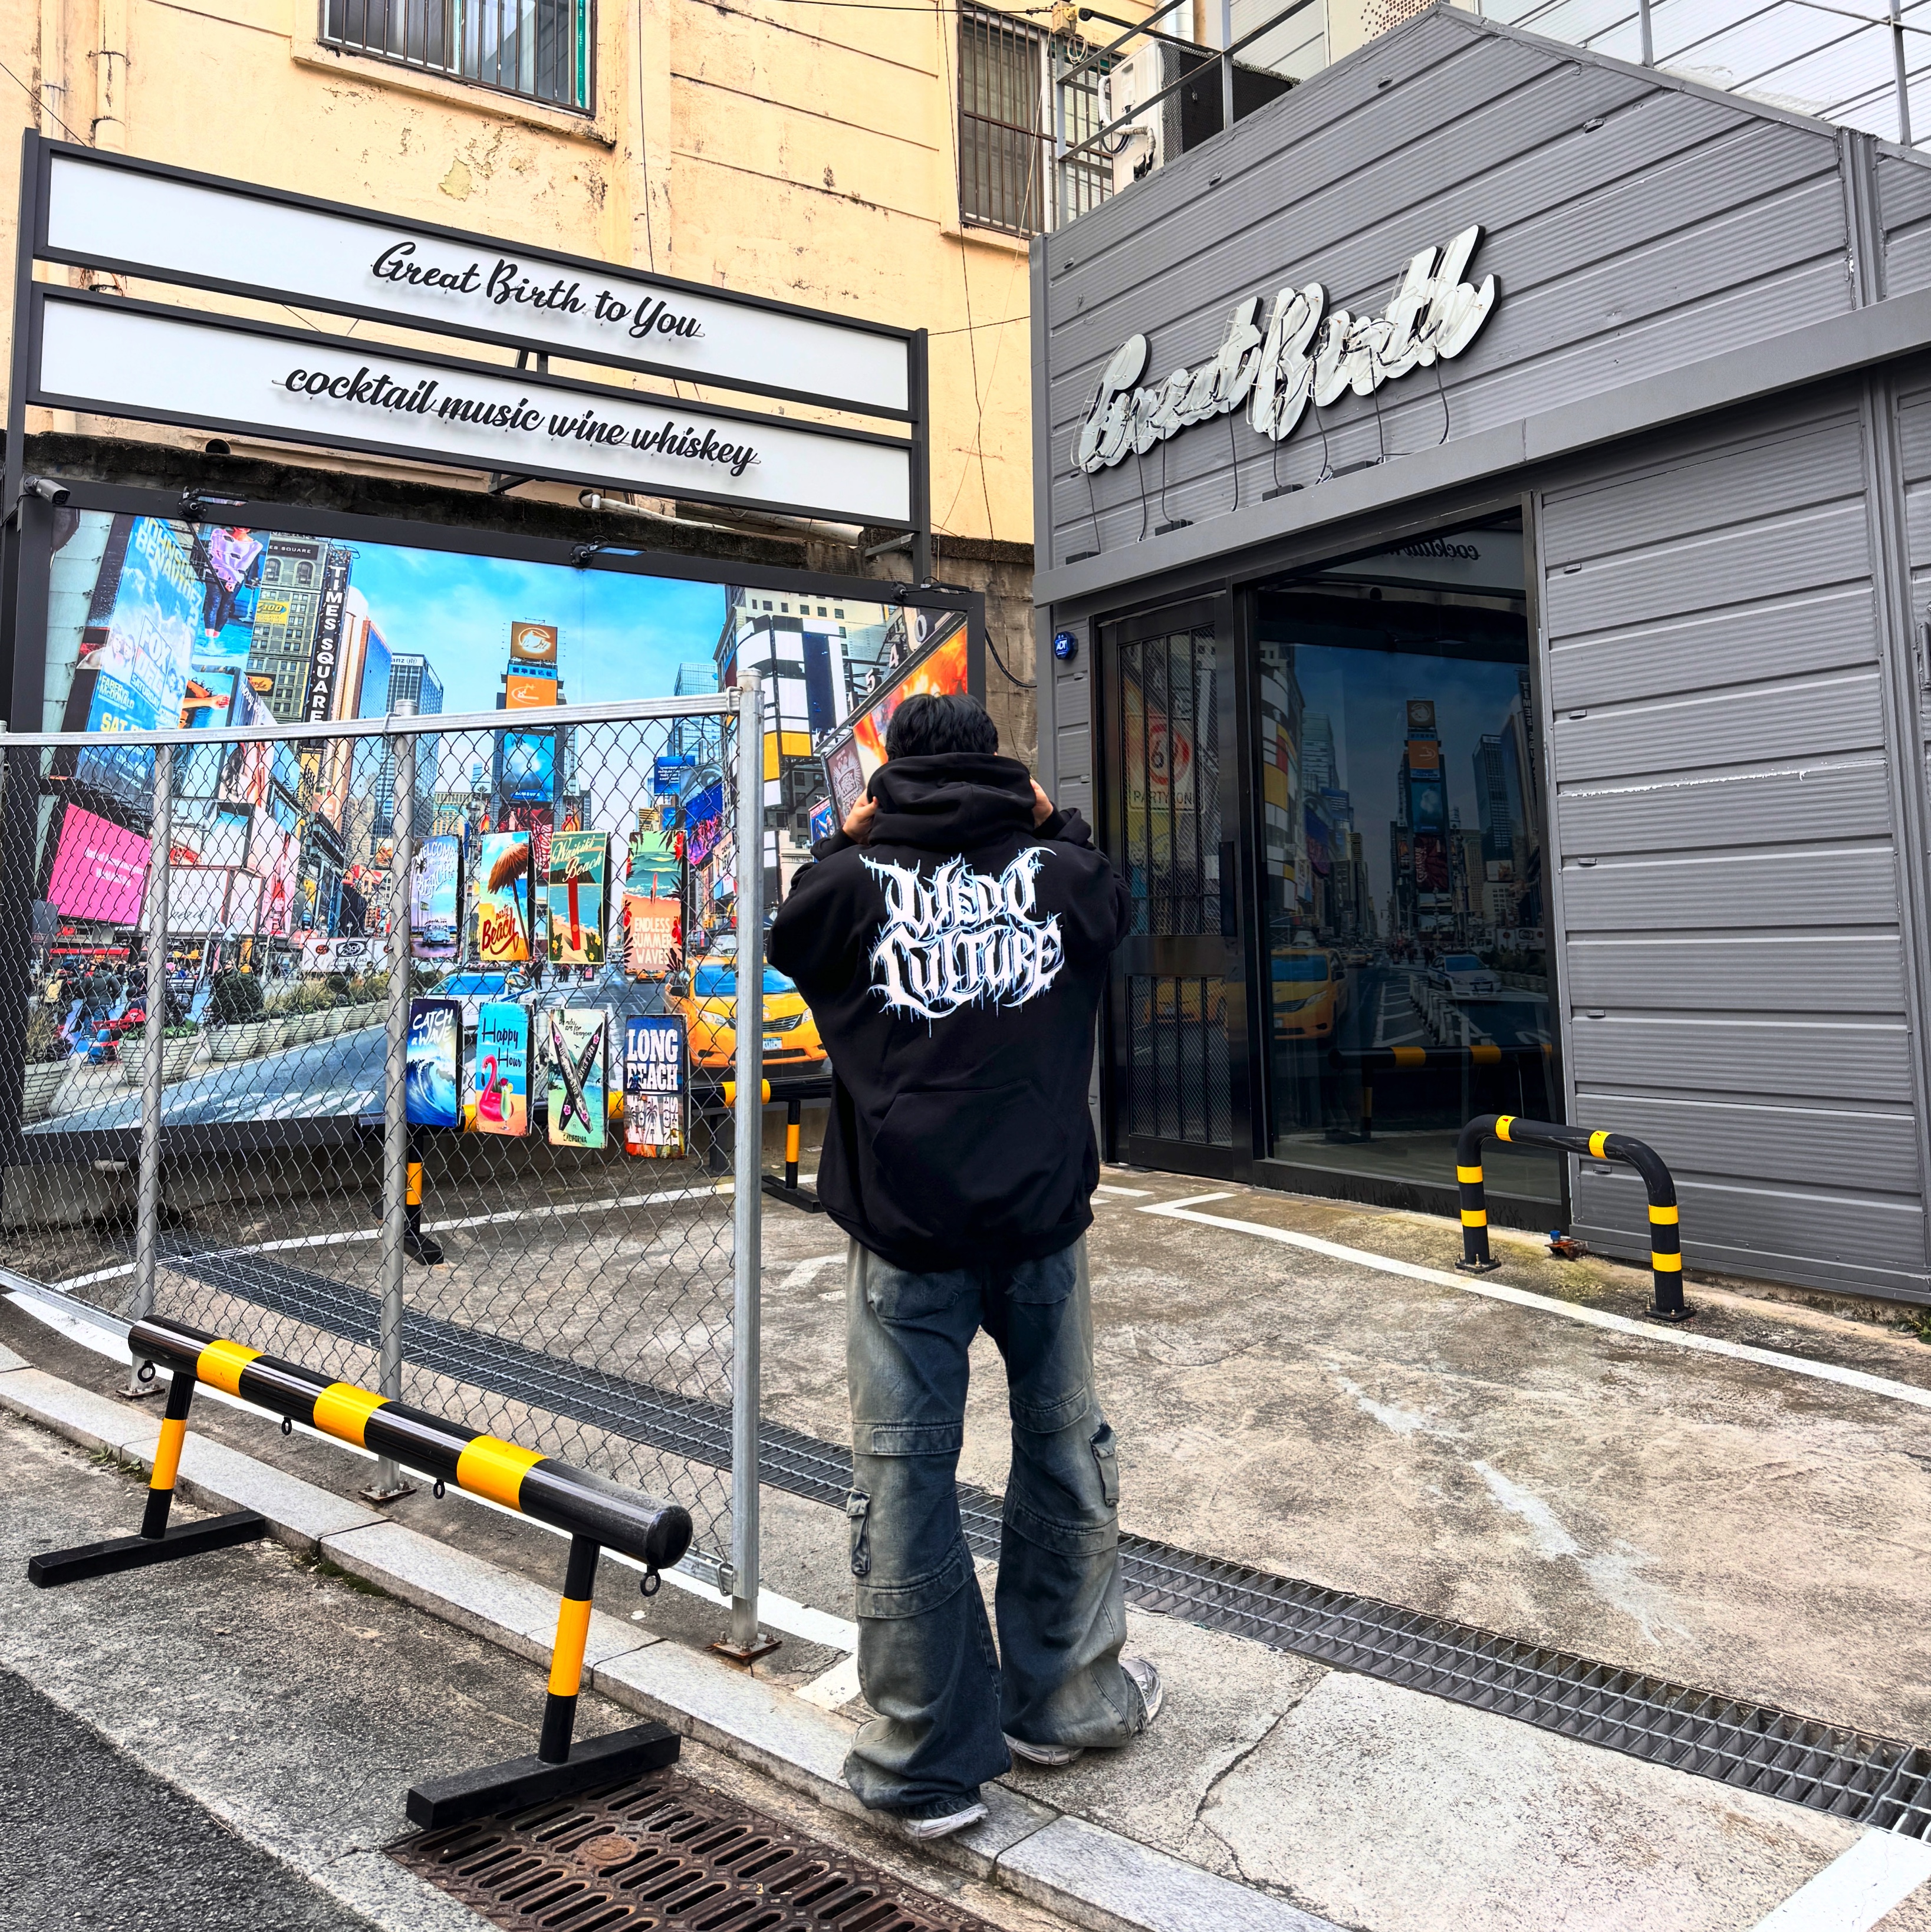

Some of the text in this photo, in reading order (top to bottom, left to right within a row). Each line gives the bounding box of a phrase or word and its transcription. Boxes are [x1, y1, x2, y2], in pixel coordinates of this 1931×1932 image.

[371, 242, 702, 339] Great Birth to You
[285, 366, 758, 477] cocktail music wine whiskey
[140, 623, 171, 674] FOX
[310, 566, 346, 723] TIMES SQUARE
[1056, 640, 1067, 651] ADT
[131, 673, 160, 708] SATURDAY
[101, 712, 129, 732] SAT
[552, 835, 596, 865] Waikiki
[562, 851, 603, 883] Beach
[482, 907, 519, 955] Beach
[634, 917, 670, 933] ENDLESS
[633, 932, 672, 949] SUMMER
[636, 948, 670, 965] WAVES
[867, 913, 1065, 1025] CULTURE
[413, 1009, 453, 1030] CATCH
[482, 1018, 519, 1049] Happy
[418, 1026, 452, 1046] WAVE
[627, 1029, 678, 1062] LONG
[496, 1047, 522, 1068] Hour
[578, 1059, 588, 1079] SINCE
[627, 1062, 678, 1090] BEACH
[563, 1134, 588, 1143] CALIFORNIA
